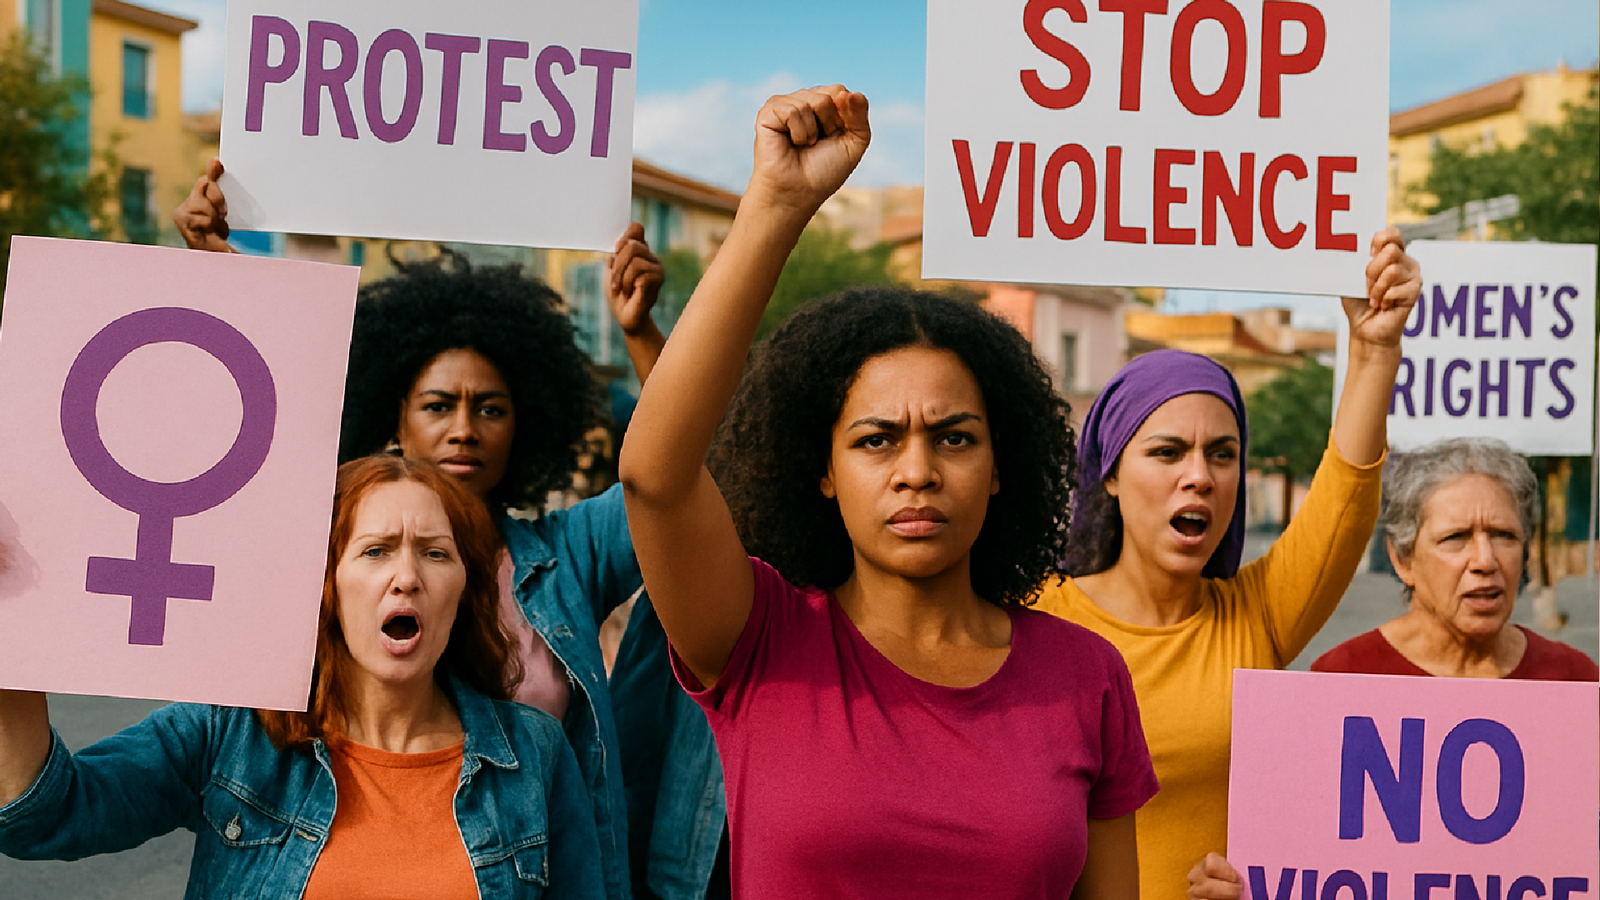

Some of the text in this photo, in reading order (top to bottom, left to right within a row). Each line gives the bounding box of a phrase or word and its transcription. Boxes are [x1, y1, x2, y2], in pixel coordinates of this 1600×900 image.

[245, 15, 632, 158] PROTEST
[1020, 0, 1326, 118] STOP
[952, 139, 1358, 252] VIOLENCE
[1402, 285, 1578, 338] OMEN'S
[1387, 357, 1576, 419] RIGHTS
[1339, 716, 1525, 845] NO
